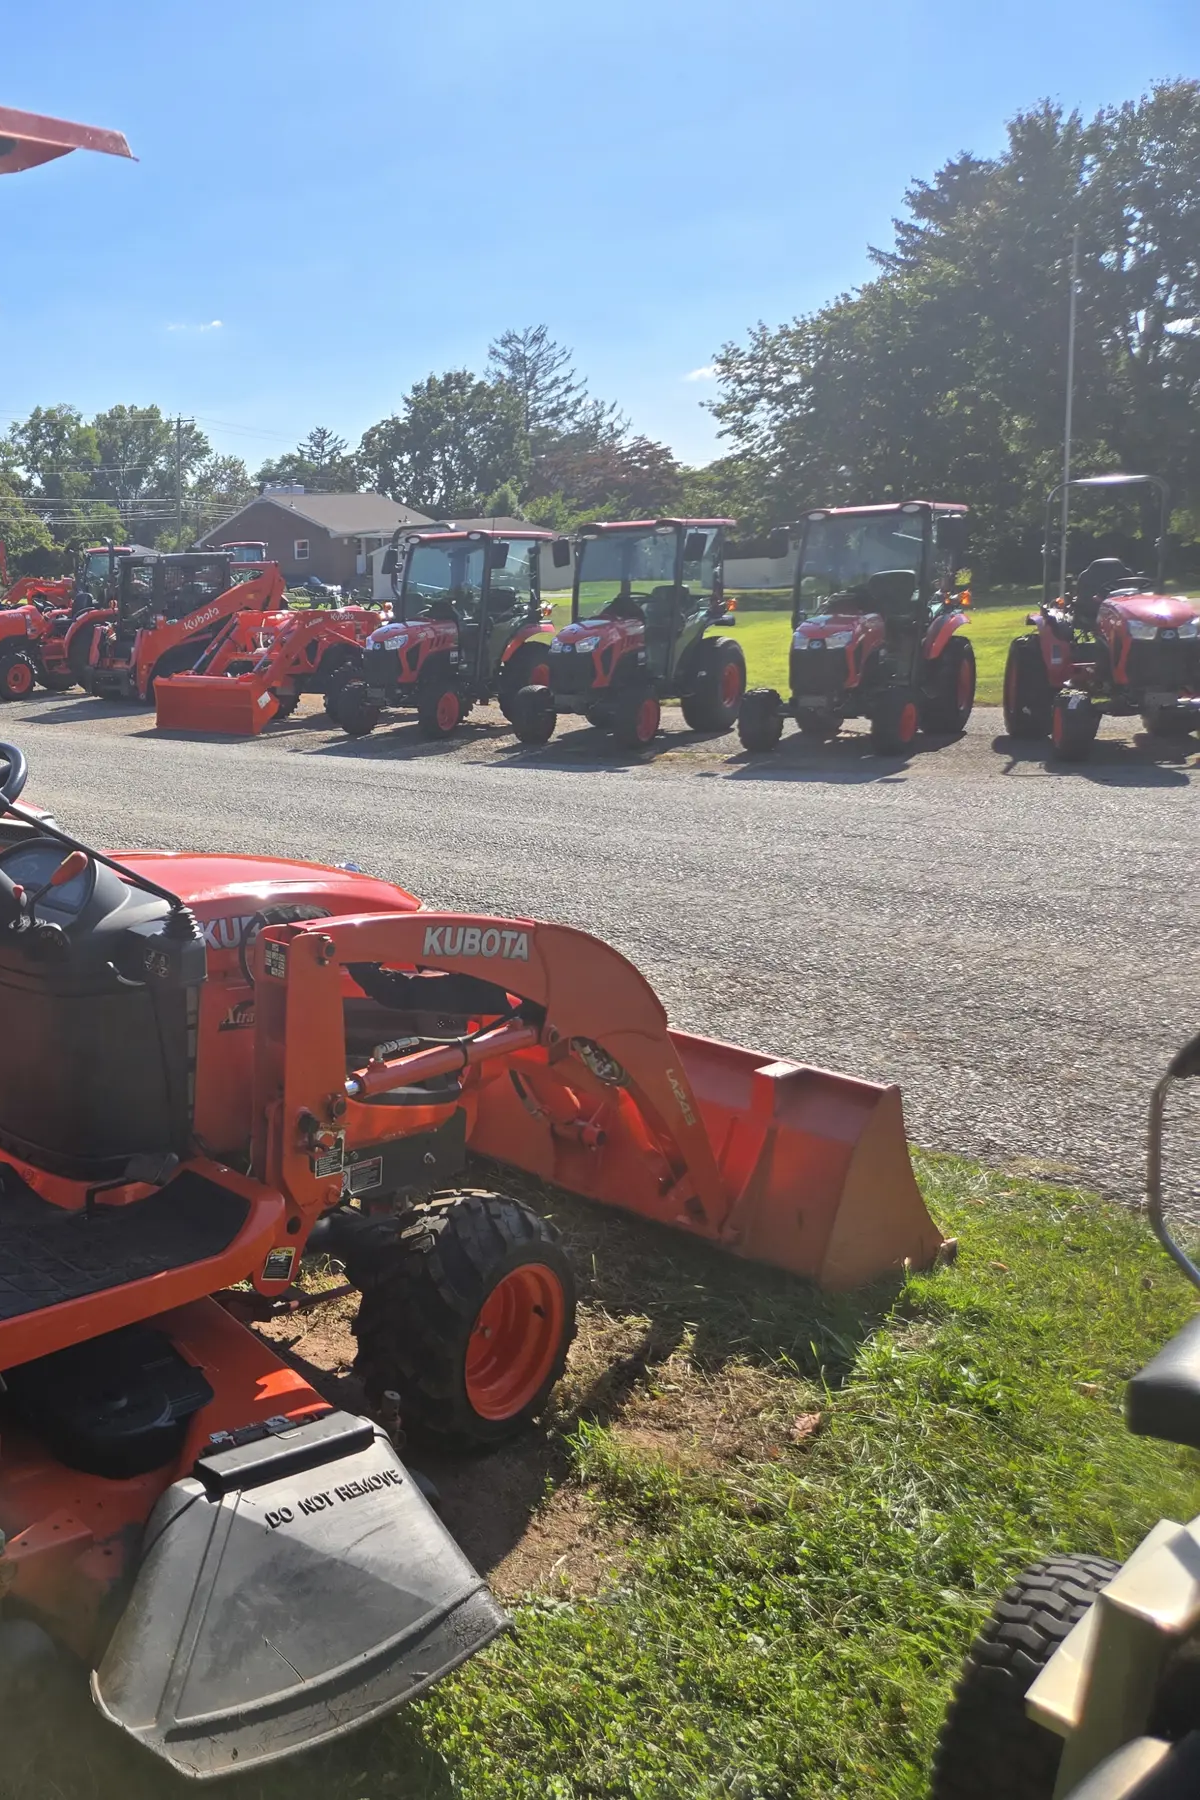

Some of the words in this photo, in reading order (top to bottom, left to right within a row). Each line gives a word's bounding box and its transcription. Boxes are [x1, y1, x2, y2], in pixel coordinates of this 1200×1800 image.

[184, 607, 220, 630] Kubota
[330, 612, 354, 621] Kubota
[422, 925, 529, 961] KUBOTA
[264, 1507, 295, 1529] DO
[298, 1491, 335, 1516] NOT
[334, 1469, 404, 1502] REMOVE
